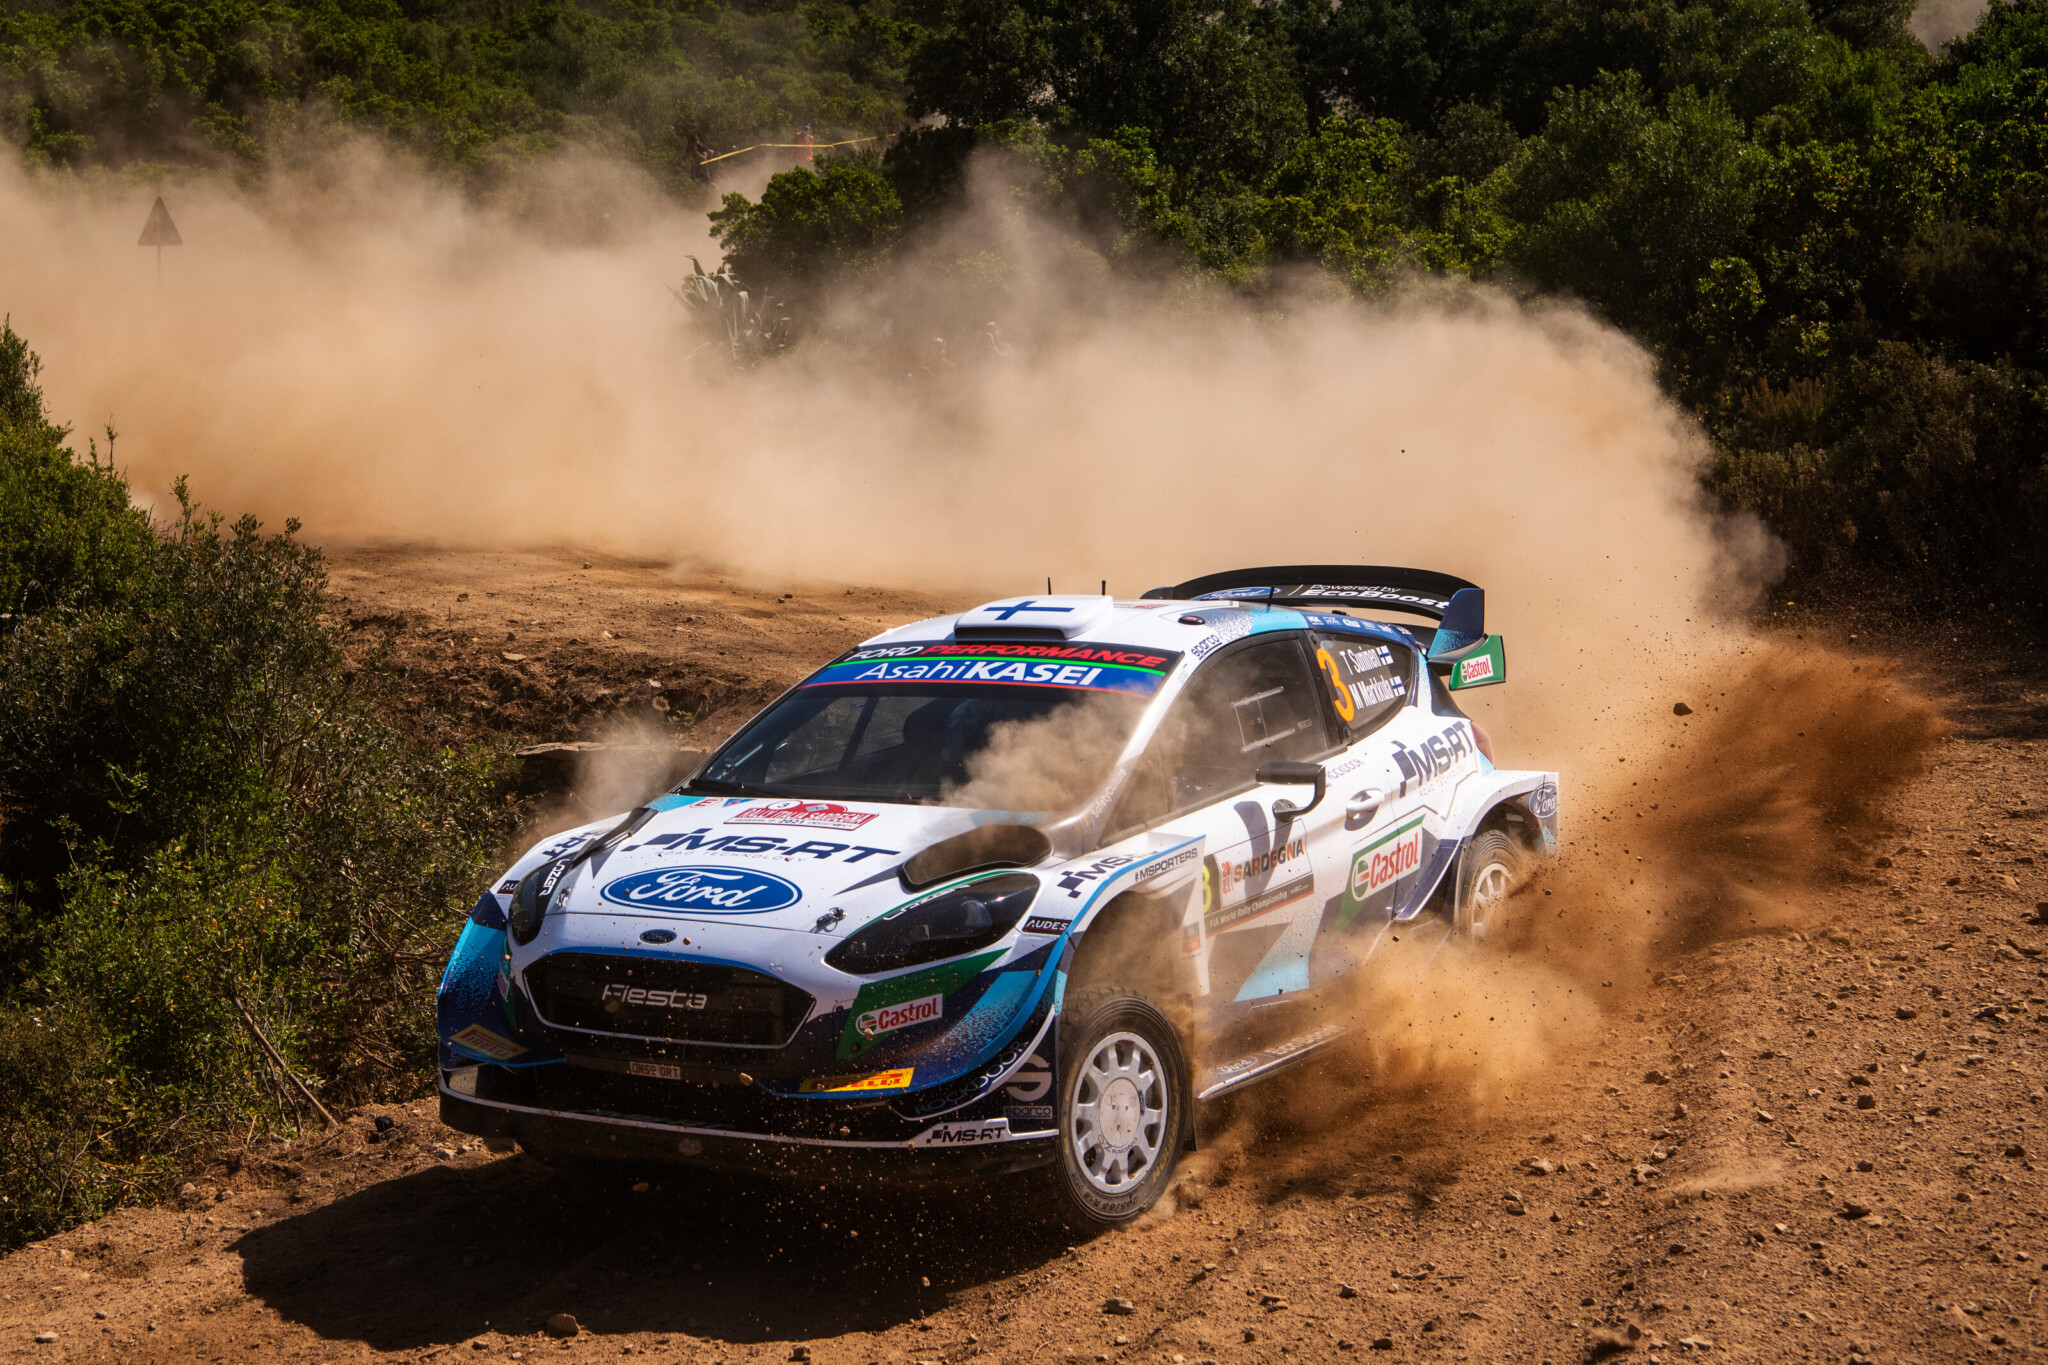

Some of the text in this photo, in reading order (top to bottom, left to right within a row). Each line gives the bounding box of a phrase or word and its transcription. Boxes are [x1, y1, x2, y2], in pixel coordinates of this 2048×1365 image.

[1300, 589, 1451, 609] EcoBoost
[1310, 584, 1379, 592] Powered
[845, 644, 1168, 667] FORD PERFORMANCE
[1191, 634, 1220, 657] sparco
[1339, 650, 1354, 676] T
[1466, 657, 1492, 680] Castrol
[1316, 648, 1355, 722] 3
[1134, 847, 1198, 882] #MSPORTERS
[1233, 838, 1305, 883] SARDEGNA
[1370, 832, 1418, 889] Castrol
[629, 869, 769, 908] Ford
[1209, 919, 1220, 929] FIA
[1219, 911, 1237, 924] World
[1237, 904, 1252, 918] Rally
[1251, 889, 1288, 912] Championship
[1026, 919, 1069, 931] AUDES
[601, 983, 708, 1010] Fiesta
[878, 997, 939, 1030] Castrol
[914, 1040, 1030, 1115] ROCKDOOR
[1004, 1106, 1052, 1117] sparco
[1111, 1136, 1138, 1155] RACING
